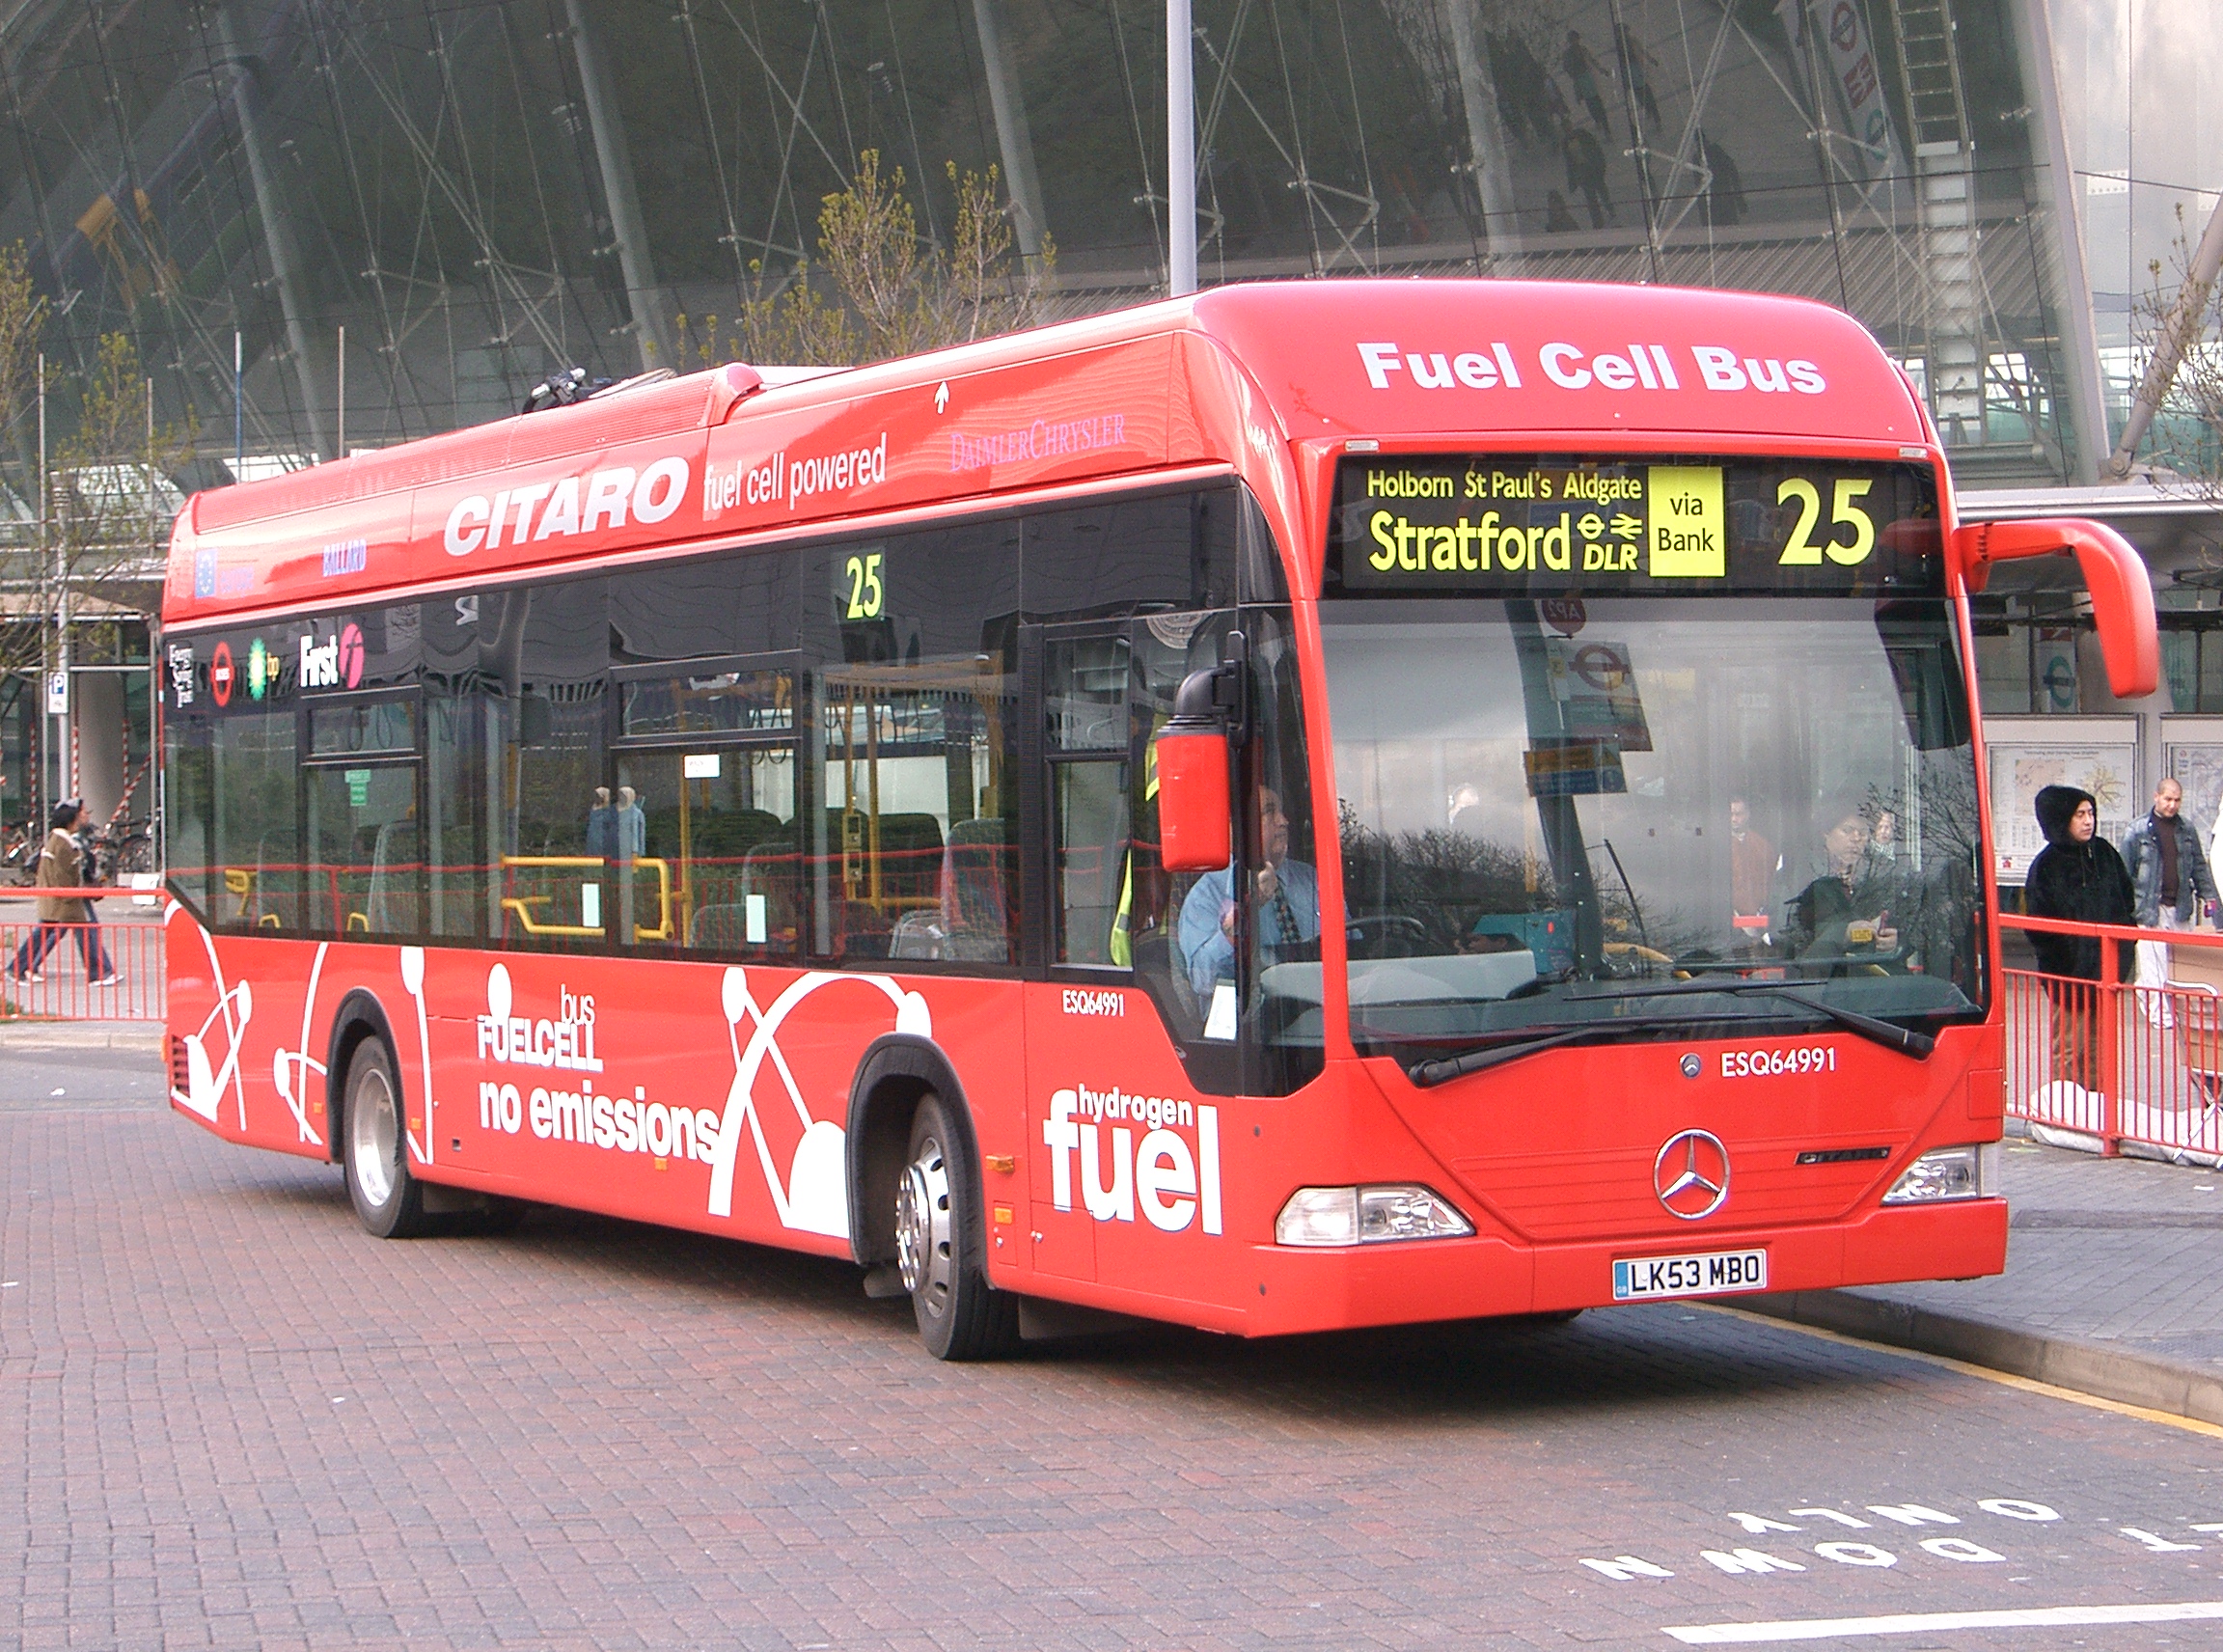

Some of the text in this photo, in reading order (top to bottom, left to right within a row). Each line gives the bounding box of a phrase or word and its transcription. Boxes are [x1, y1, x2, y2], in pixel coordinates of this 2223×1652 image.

[1357, 342, 1826, 396] Fuel Cell Bus
[443, 431, 887, 558] CITARO fuel cell powered
[1367, 470, 1642, 507] Holborn St Paul's Aldgate
[1669, 492, 1703, 517] via
[1368, 509, 1571, 572] Stratford
[1658, 527, 1715, 553] Bank
[1776, 478, 1876, 566] 25
[1582, 543, 1638, 571] DLR
[846, 553, 883, 620] 25
[300, 634, 339, 688] First
[561, 983, 595, 1026] bus
[1062, 989, 1125, 1017] ESQ64991
[1720, 1047, 1837, 1078] ESQ64991
[479, 1079, 722, 1165] no emissions
[1078, 1083, 1194, 1131] hydrogen
[1043, 1088, 1223, 1236] fuel
[1631, 1254, 1759, 1292] LK53 MBO
[1728, 1498, 2063, 1534] ONLY
